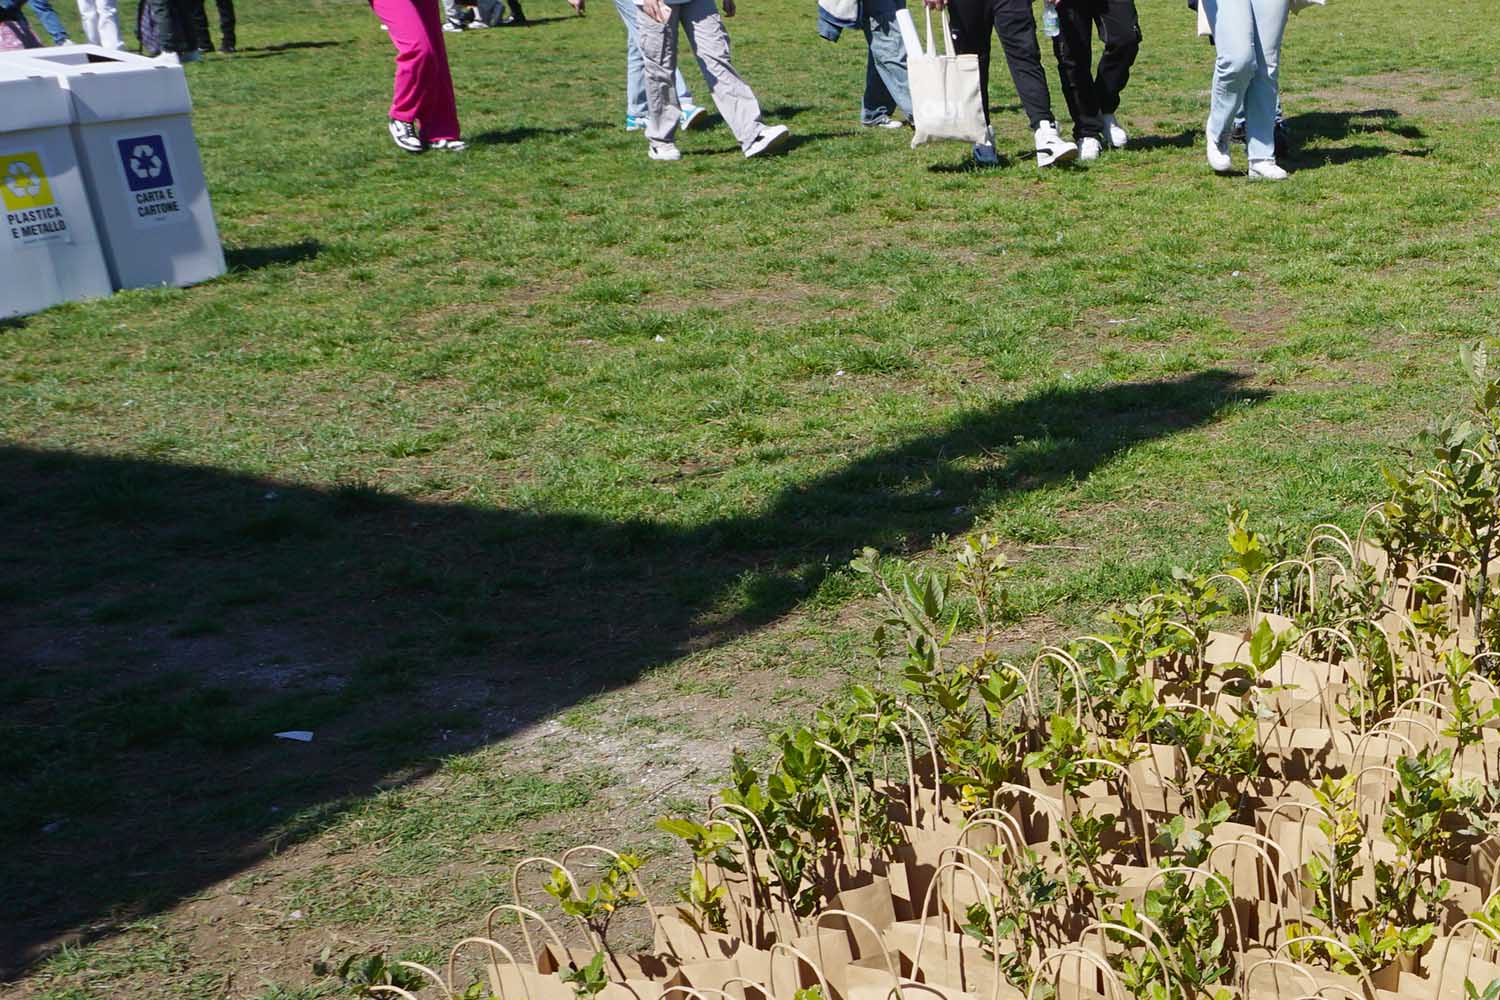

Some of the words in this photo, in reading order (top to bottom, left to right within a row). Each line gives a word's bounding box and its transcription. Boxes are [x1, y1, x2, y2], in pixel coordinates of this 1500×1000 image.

[136, 190, 167, 204] CARTA
[167, 188, 174, 199] E
[7, 206, 63, 225] PLASTICA
[11, 227, 20, 239] E
[21, 219, 66, 237] METALLO
